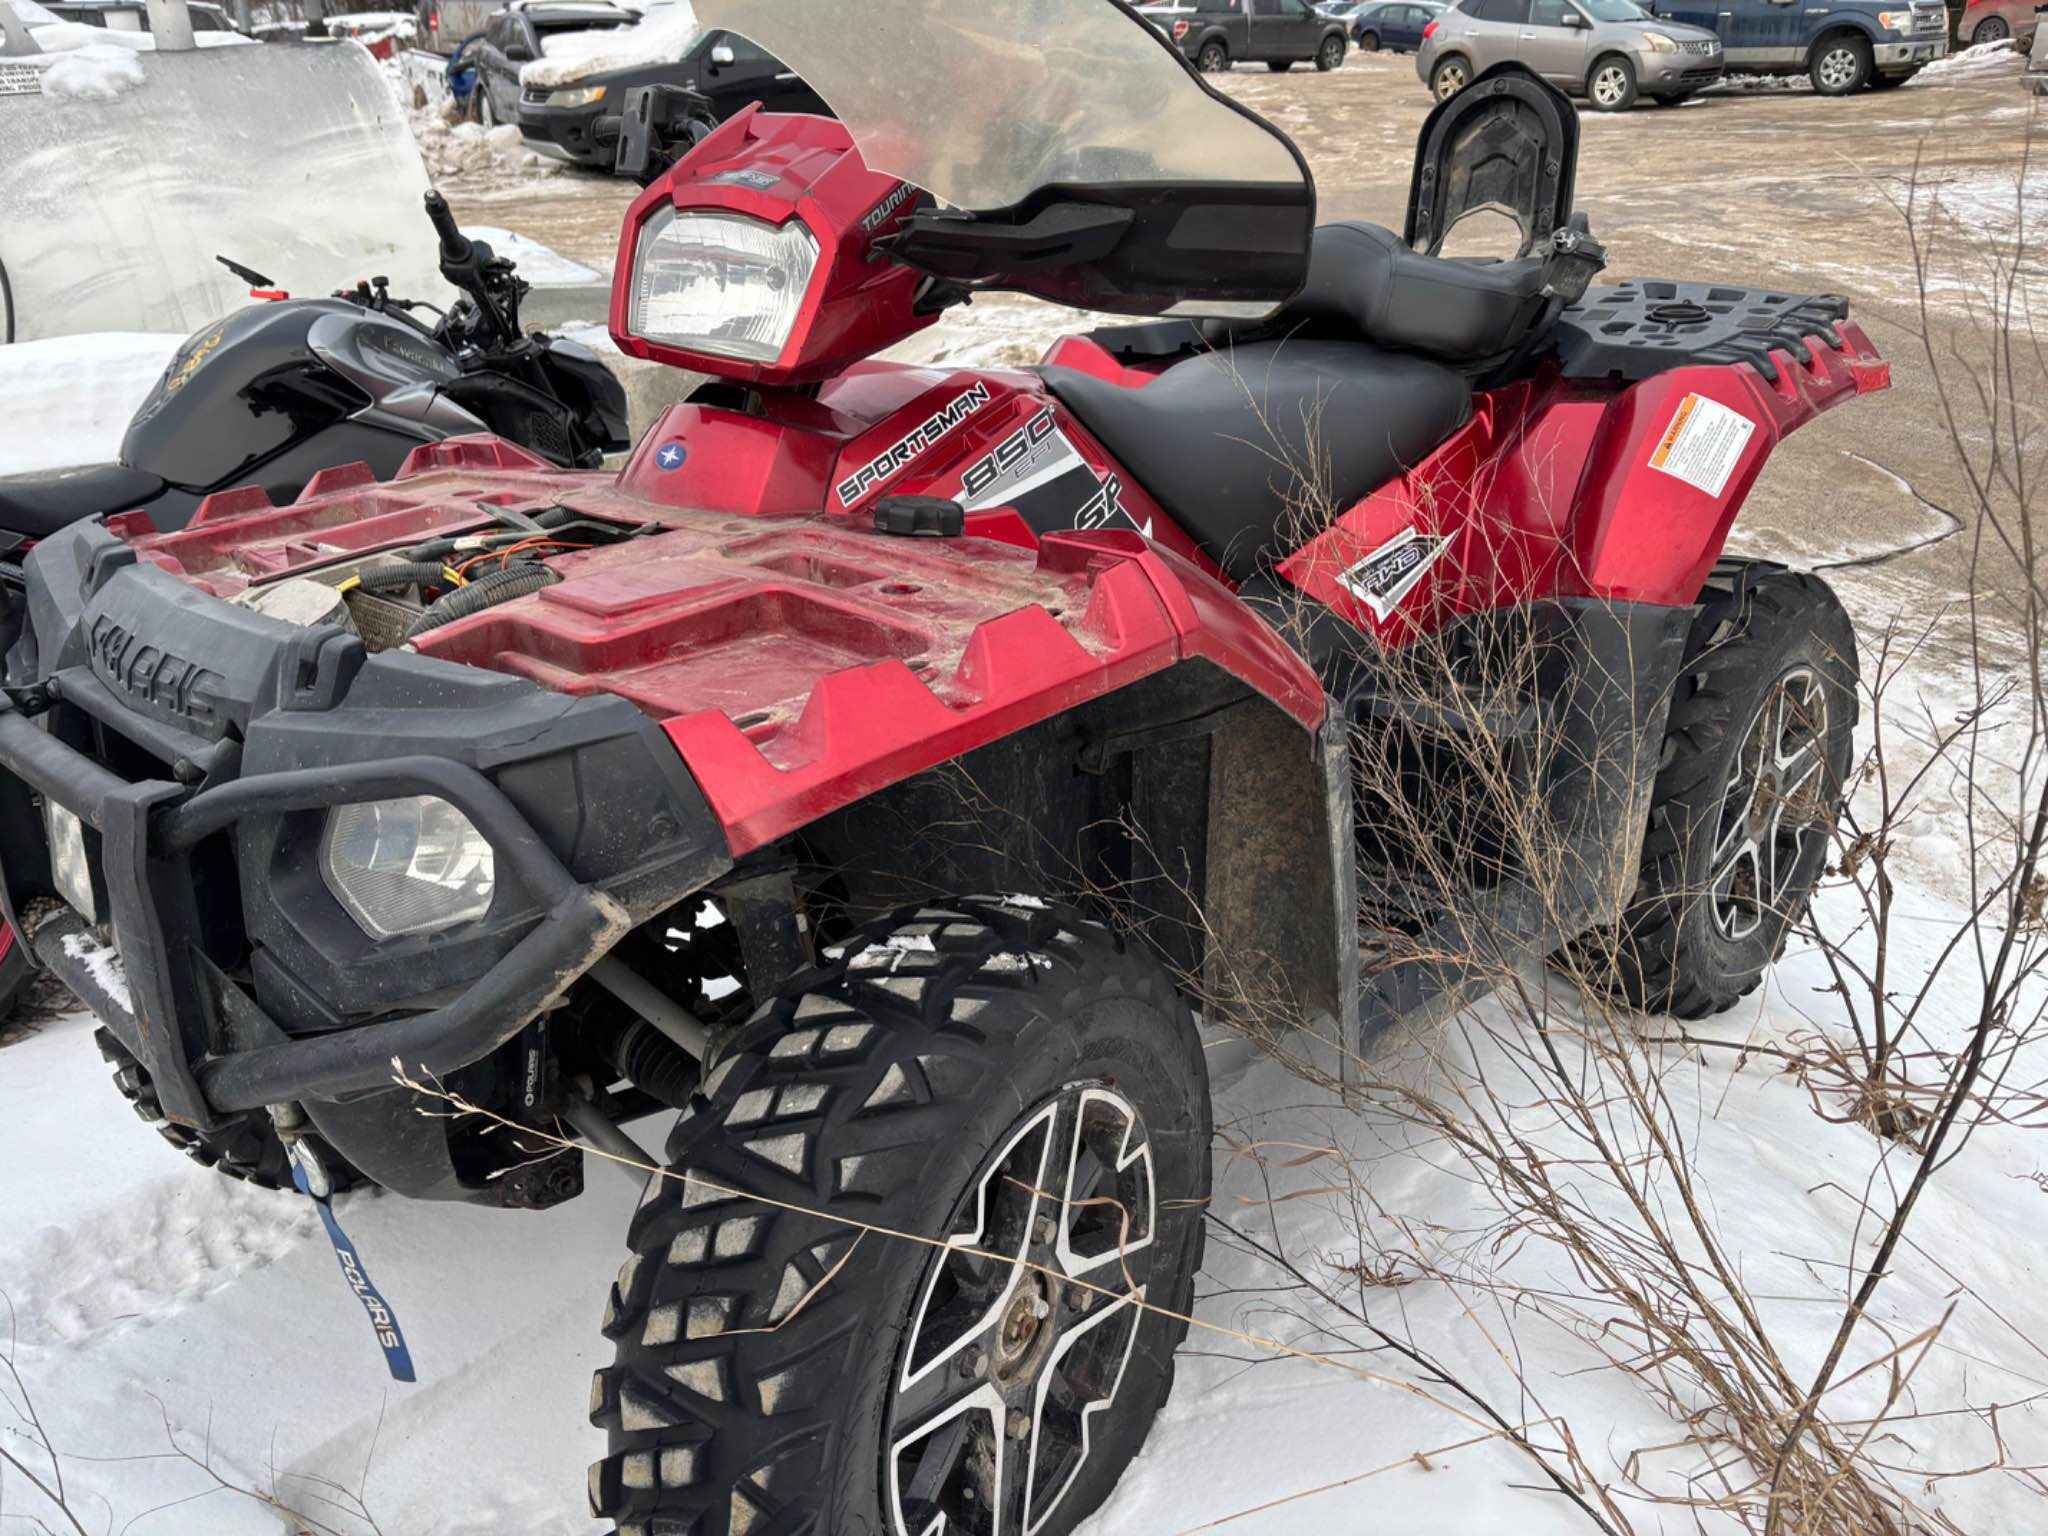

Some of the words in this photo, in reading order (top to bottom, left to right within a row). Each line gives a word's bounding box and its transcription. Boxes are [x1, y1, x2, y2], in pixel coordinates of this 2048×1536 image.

[836, 381, 990, 507] SPORTSMAN
[960, 405, 1058, 499] 850
[1073, 472, 1122, 530] SP
[91, 612, 226, 724] POLARIS
[336, 1248, 400, 1348] POLARIS
